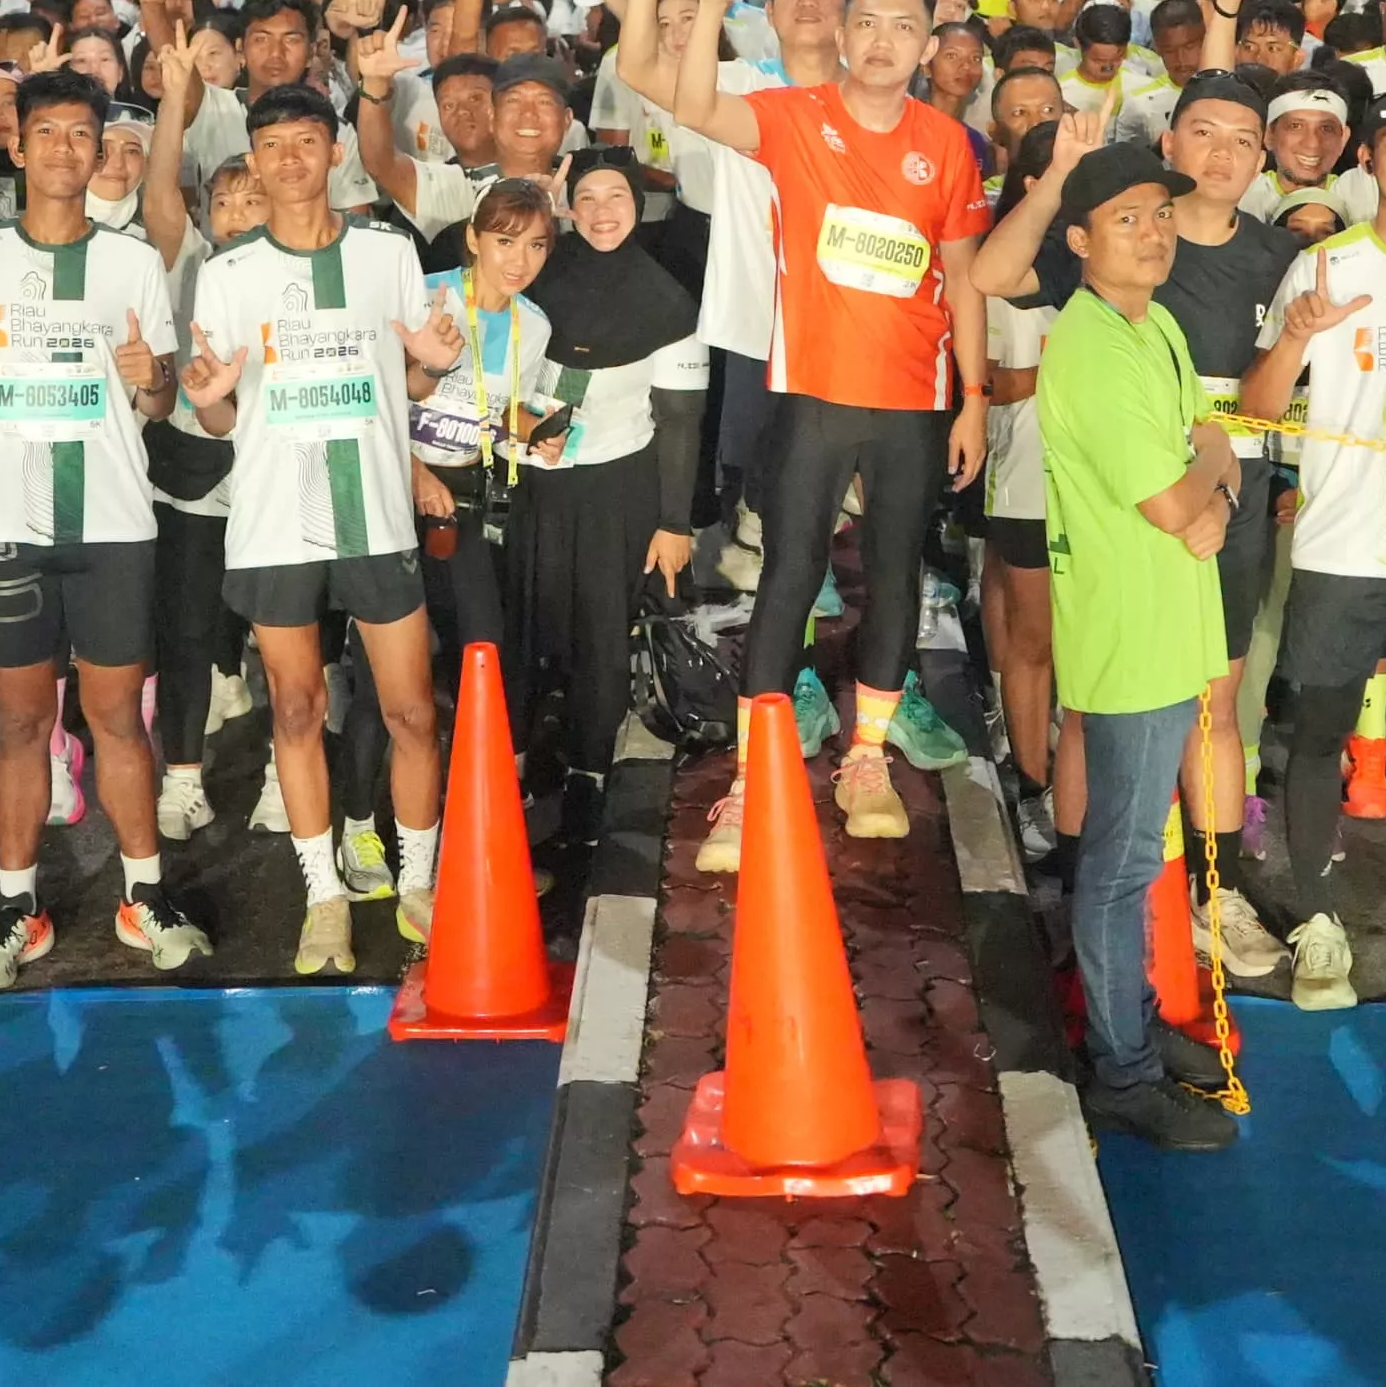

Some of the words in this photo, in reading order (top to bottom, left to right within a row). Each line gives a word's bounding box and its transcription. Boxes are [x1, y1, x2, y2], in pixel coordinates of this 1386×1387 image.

[826, 223, 926, 269] M-8020250
[10, 303, 46, 318] Riau
[11, 317, 113, 336] Bhayangkara
[277, 318, 311, 332] Riau
[11, 333, 44, 348] Run
[46, 337, 95, 349] 2026
[277, 329, 377, 349] Bhayangkara
[279, 346, 311, 361] Run
[314, 346, 359, 358] 2026
[270, 380, 372, 413] M-8054048
